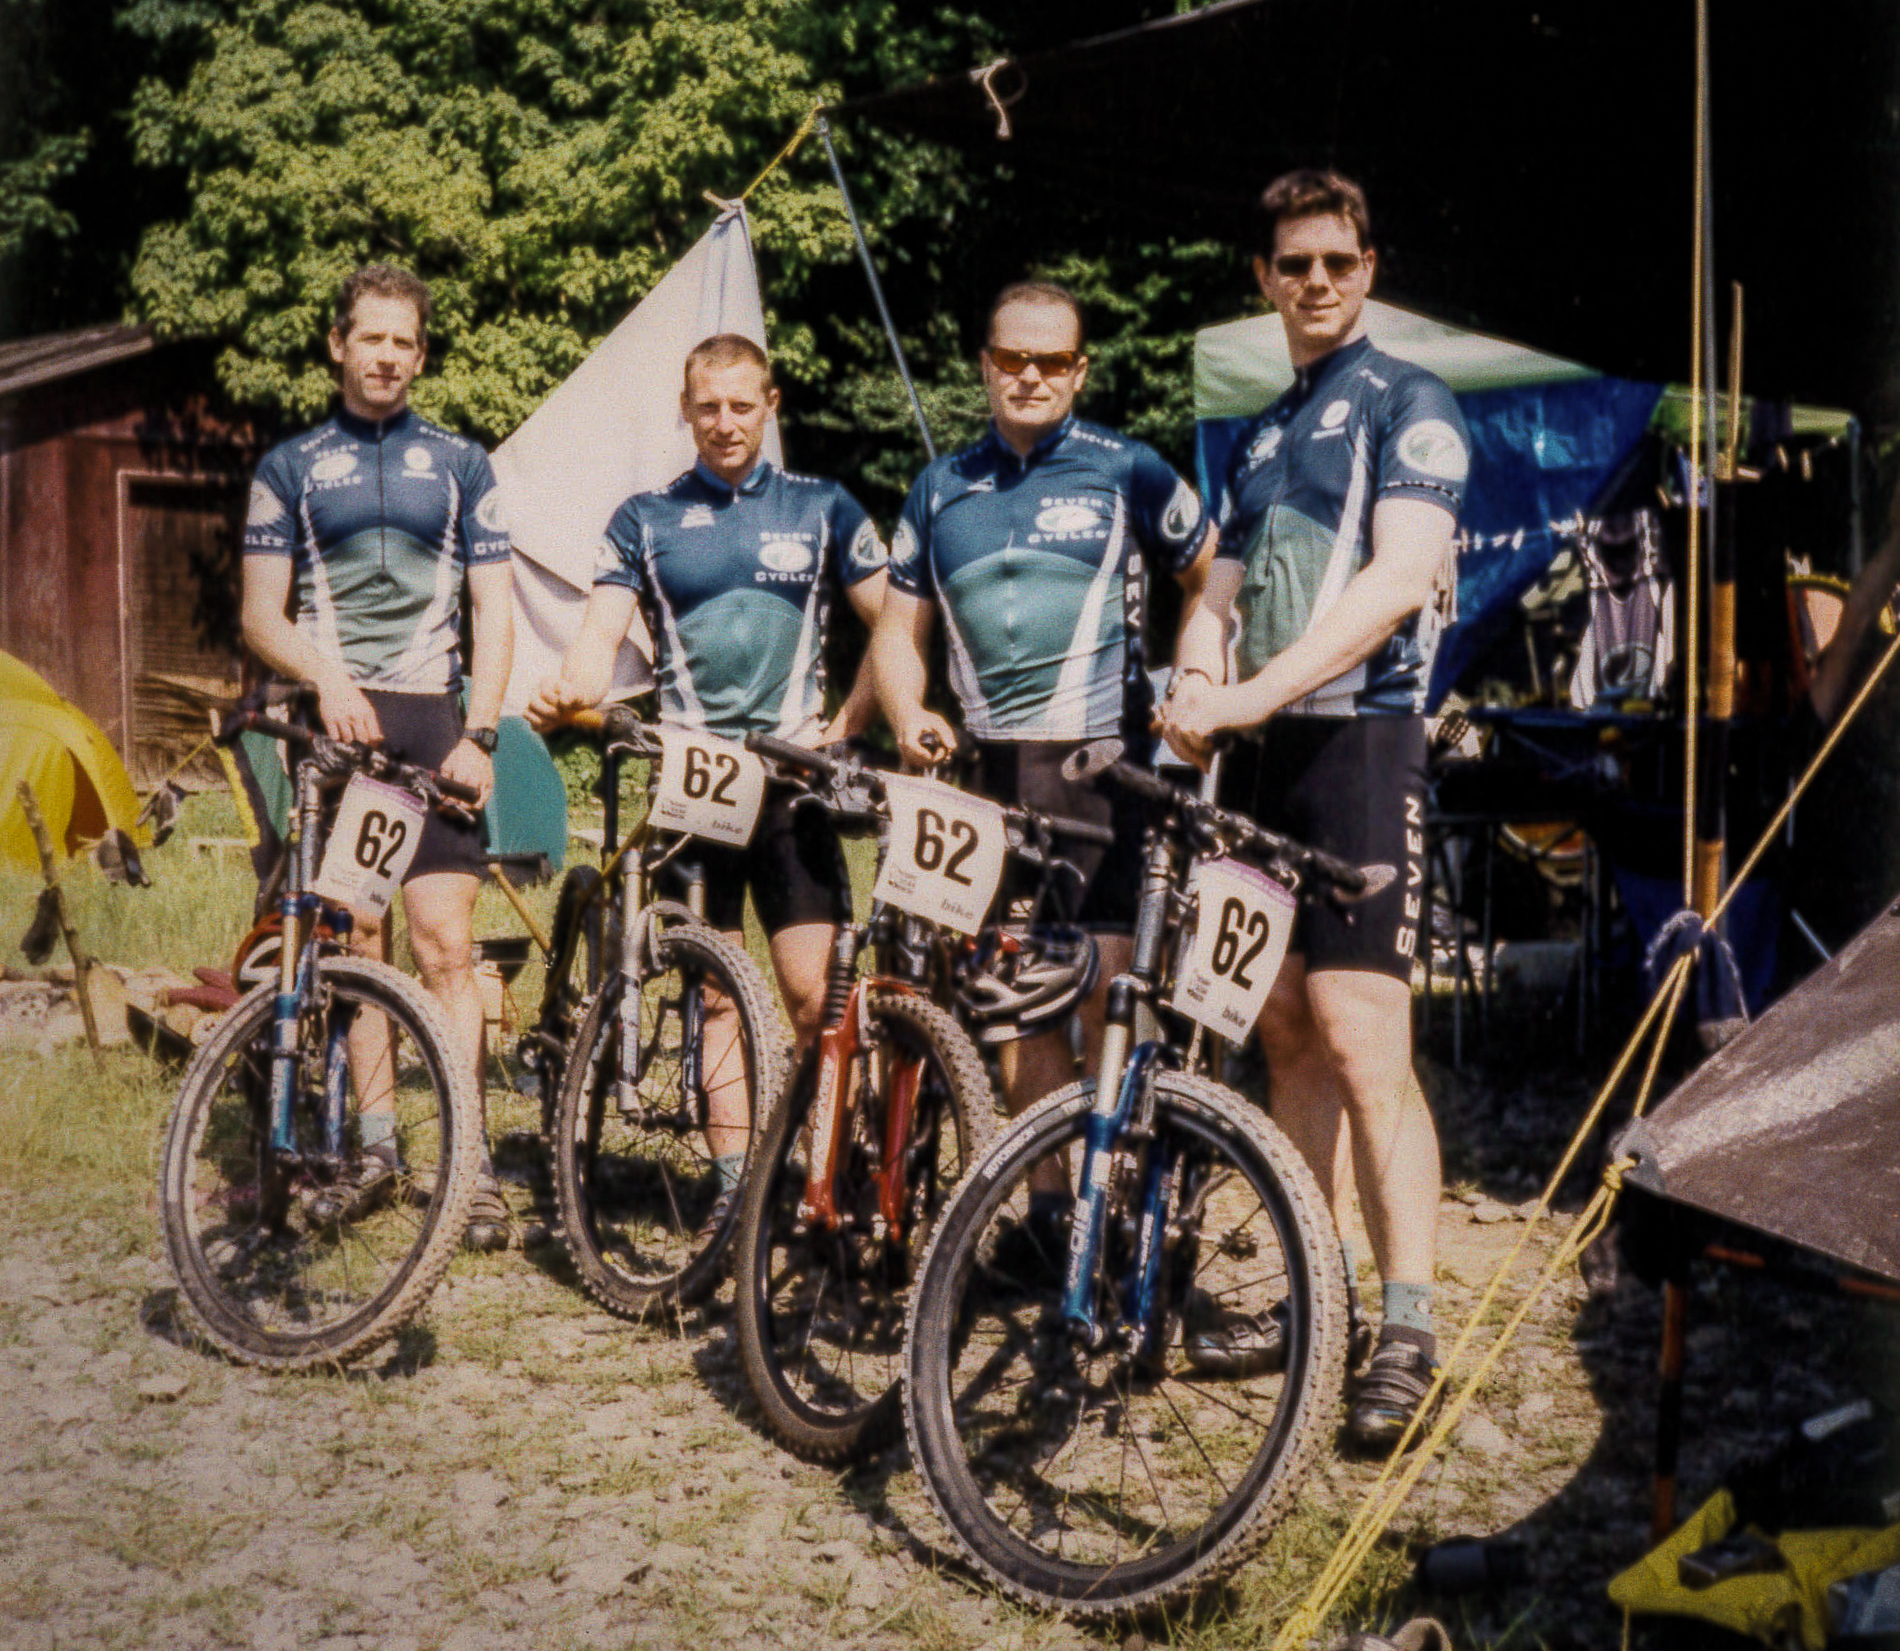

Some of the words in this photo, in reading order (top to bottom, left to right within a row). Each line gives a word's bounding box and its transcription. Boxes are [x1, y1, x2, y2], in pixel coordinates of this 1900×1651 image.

[683, 746, 740, 807] 62
[355, 810, 407, 880] 62
[914, 808, 979, 886] 62
[1396, 795, 1424, 958] SEVEN
[1211, 896, 1270, 991] 62
